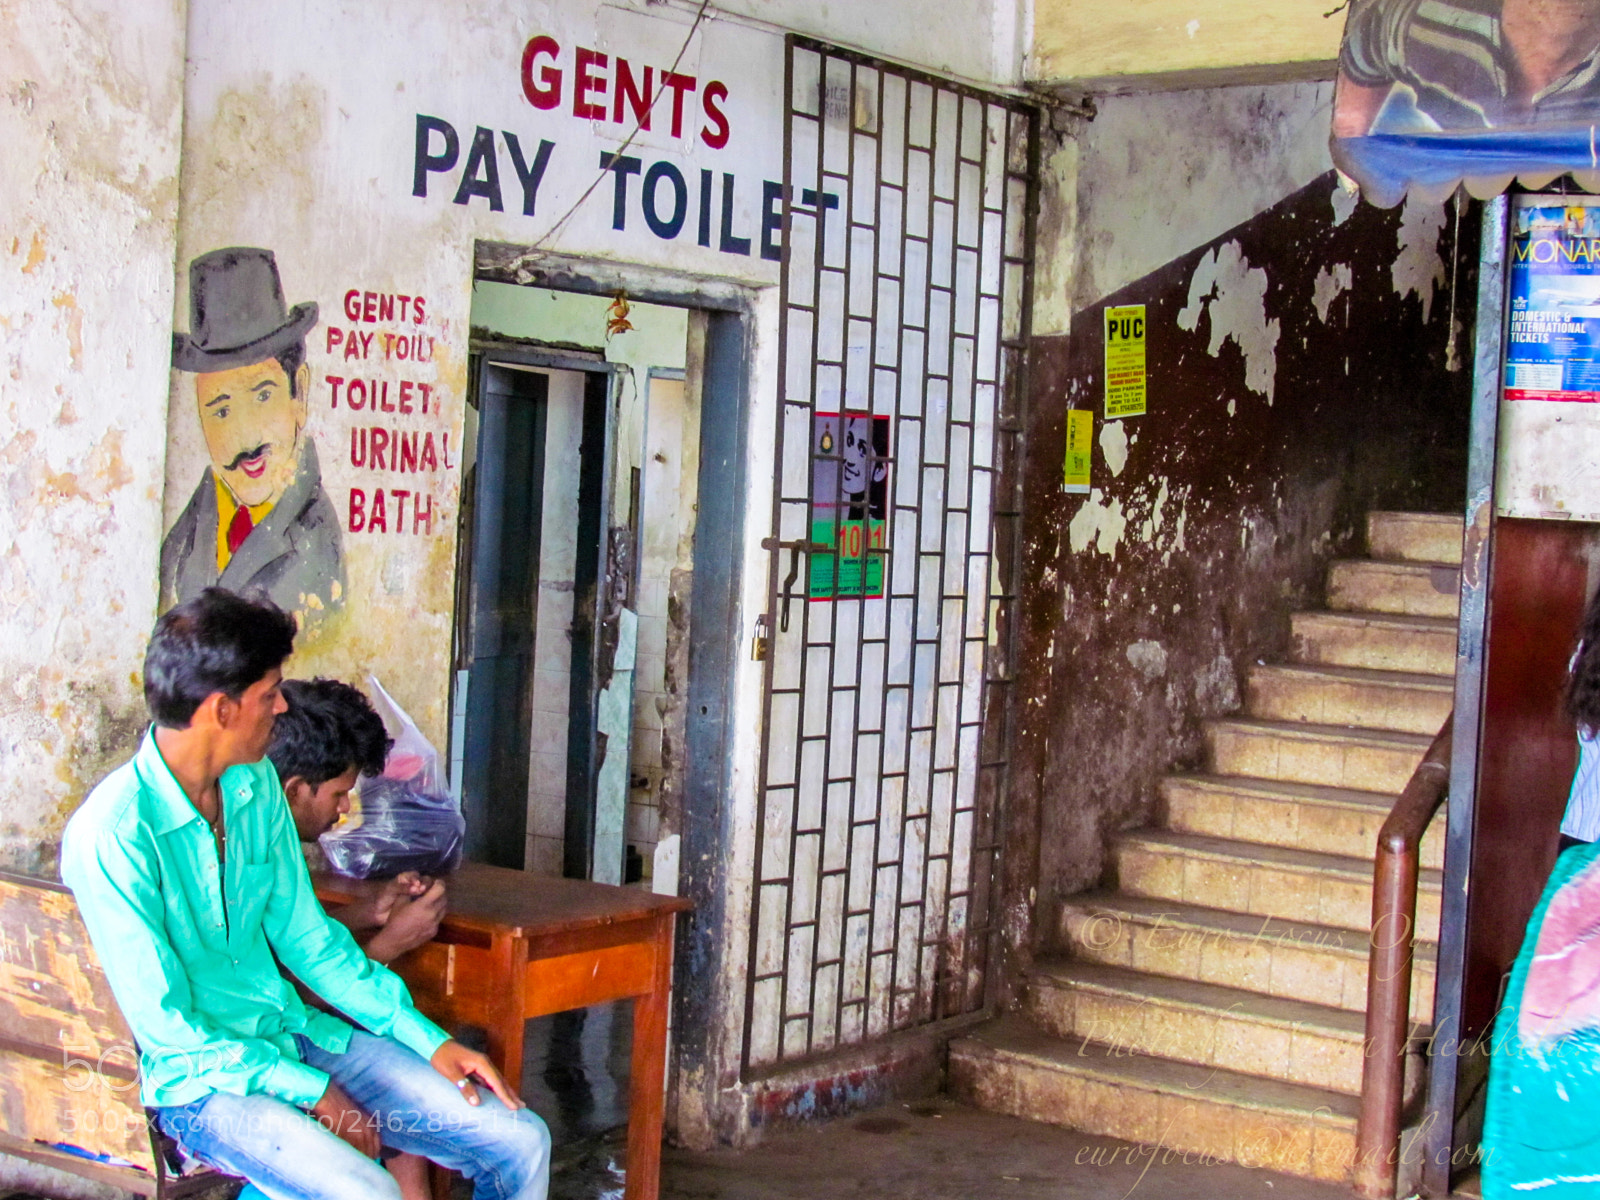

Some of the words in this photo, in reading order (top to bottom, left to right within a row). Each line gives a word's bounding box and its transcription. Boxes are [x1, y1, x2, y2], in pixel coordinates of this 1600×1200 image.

[521, 35, 729, 150] GENTS
[412, 113, 556, 217] PAY
[600, 150, 839, 267] TOILET
[344, 289, 426, 324] GENTS
[1512, 311, 1561, 322] DOMESTIC
[1564, 312, 1572, 322] &
[326, 326, 374, 362] PAY
[1108, 318, 1143, 341] PUC
[1510, 332, 1550, 344] TICKETS
[1511, 321, 1587, 334] INTERNATIONAL
[325, 375, 434, 414] TOILET
[351, 426, 453, 474] URINAL
[349, 487, 432, 536] BATH
